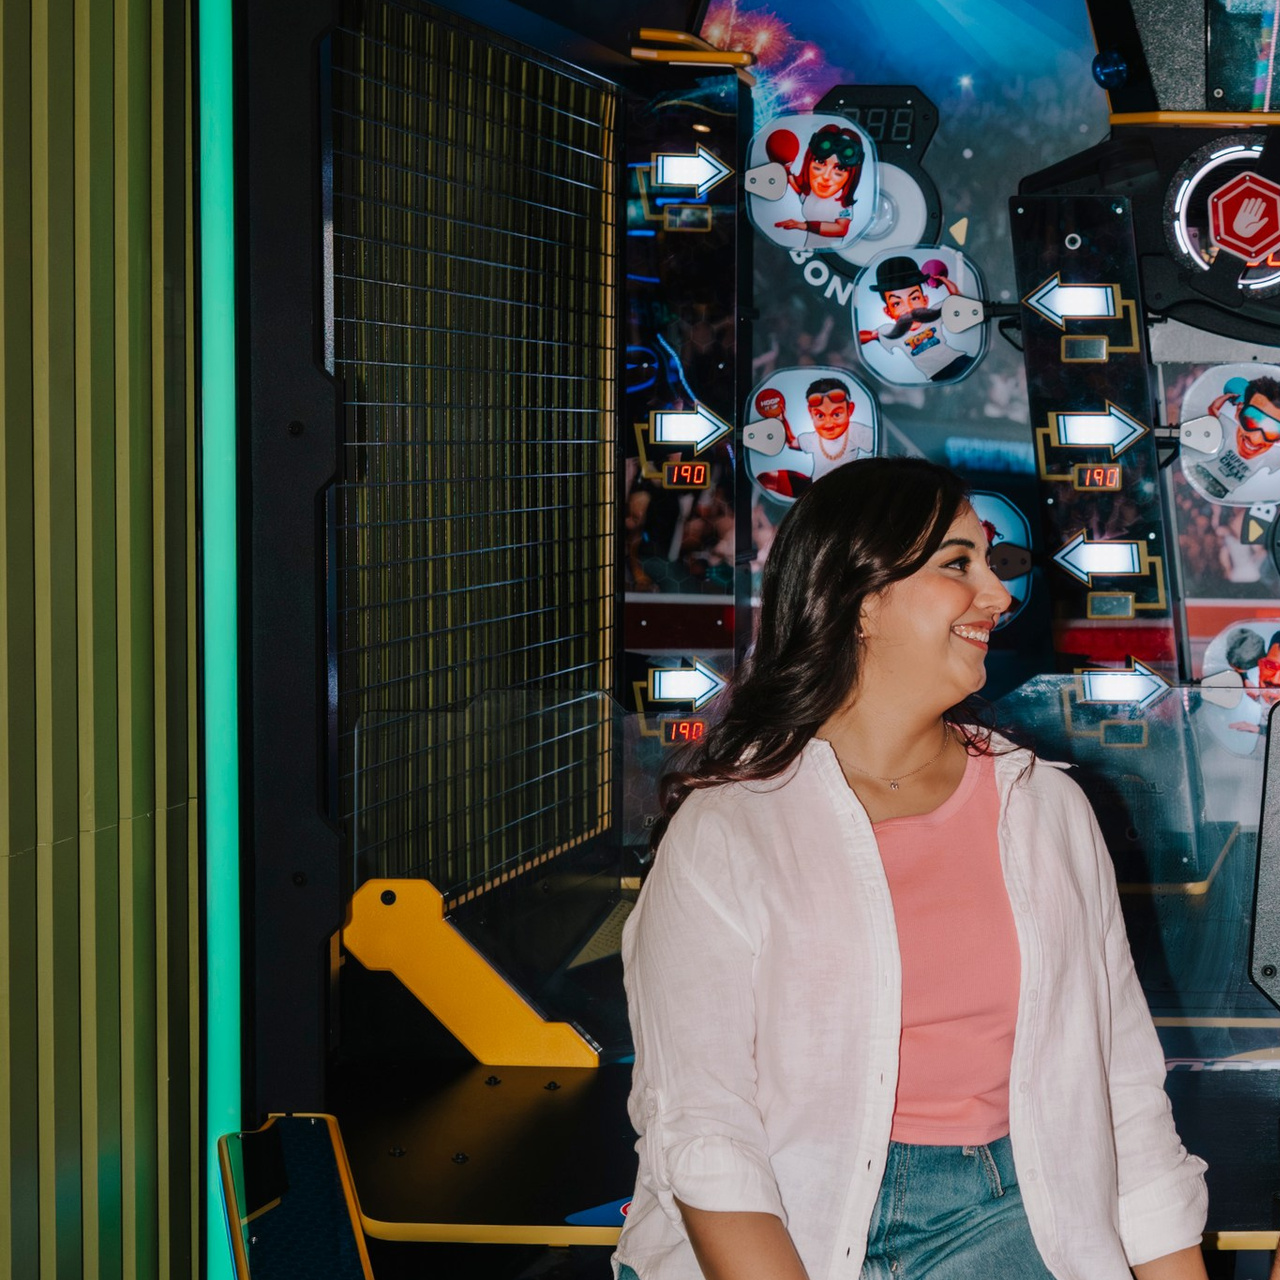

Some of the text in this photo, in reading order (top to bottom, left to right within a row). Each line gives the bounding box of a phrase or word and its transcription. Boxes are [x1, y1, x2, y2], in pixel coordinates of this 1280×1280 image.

[789, 247, 855, 307] BON
[671, 465, 705, 484] 190
[1084, 468, 1118, 487] 190
[671, 722, 704, 740] 190
